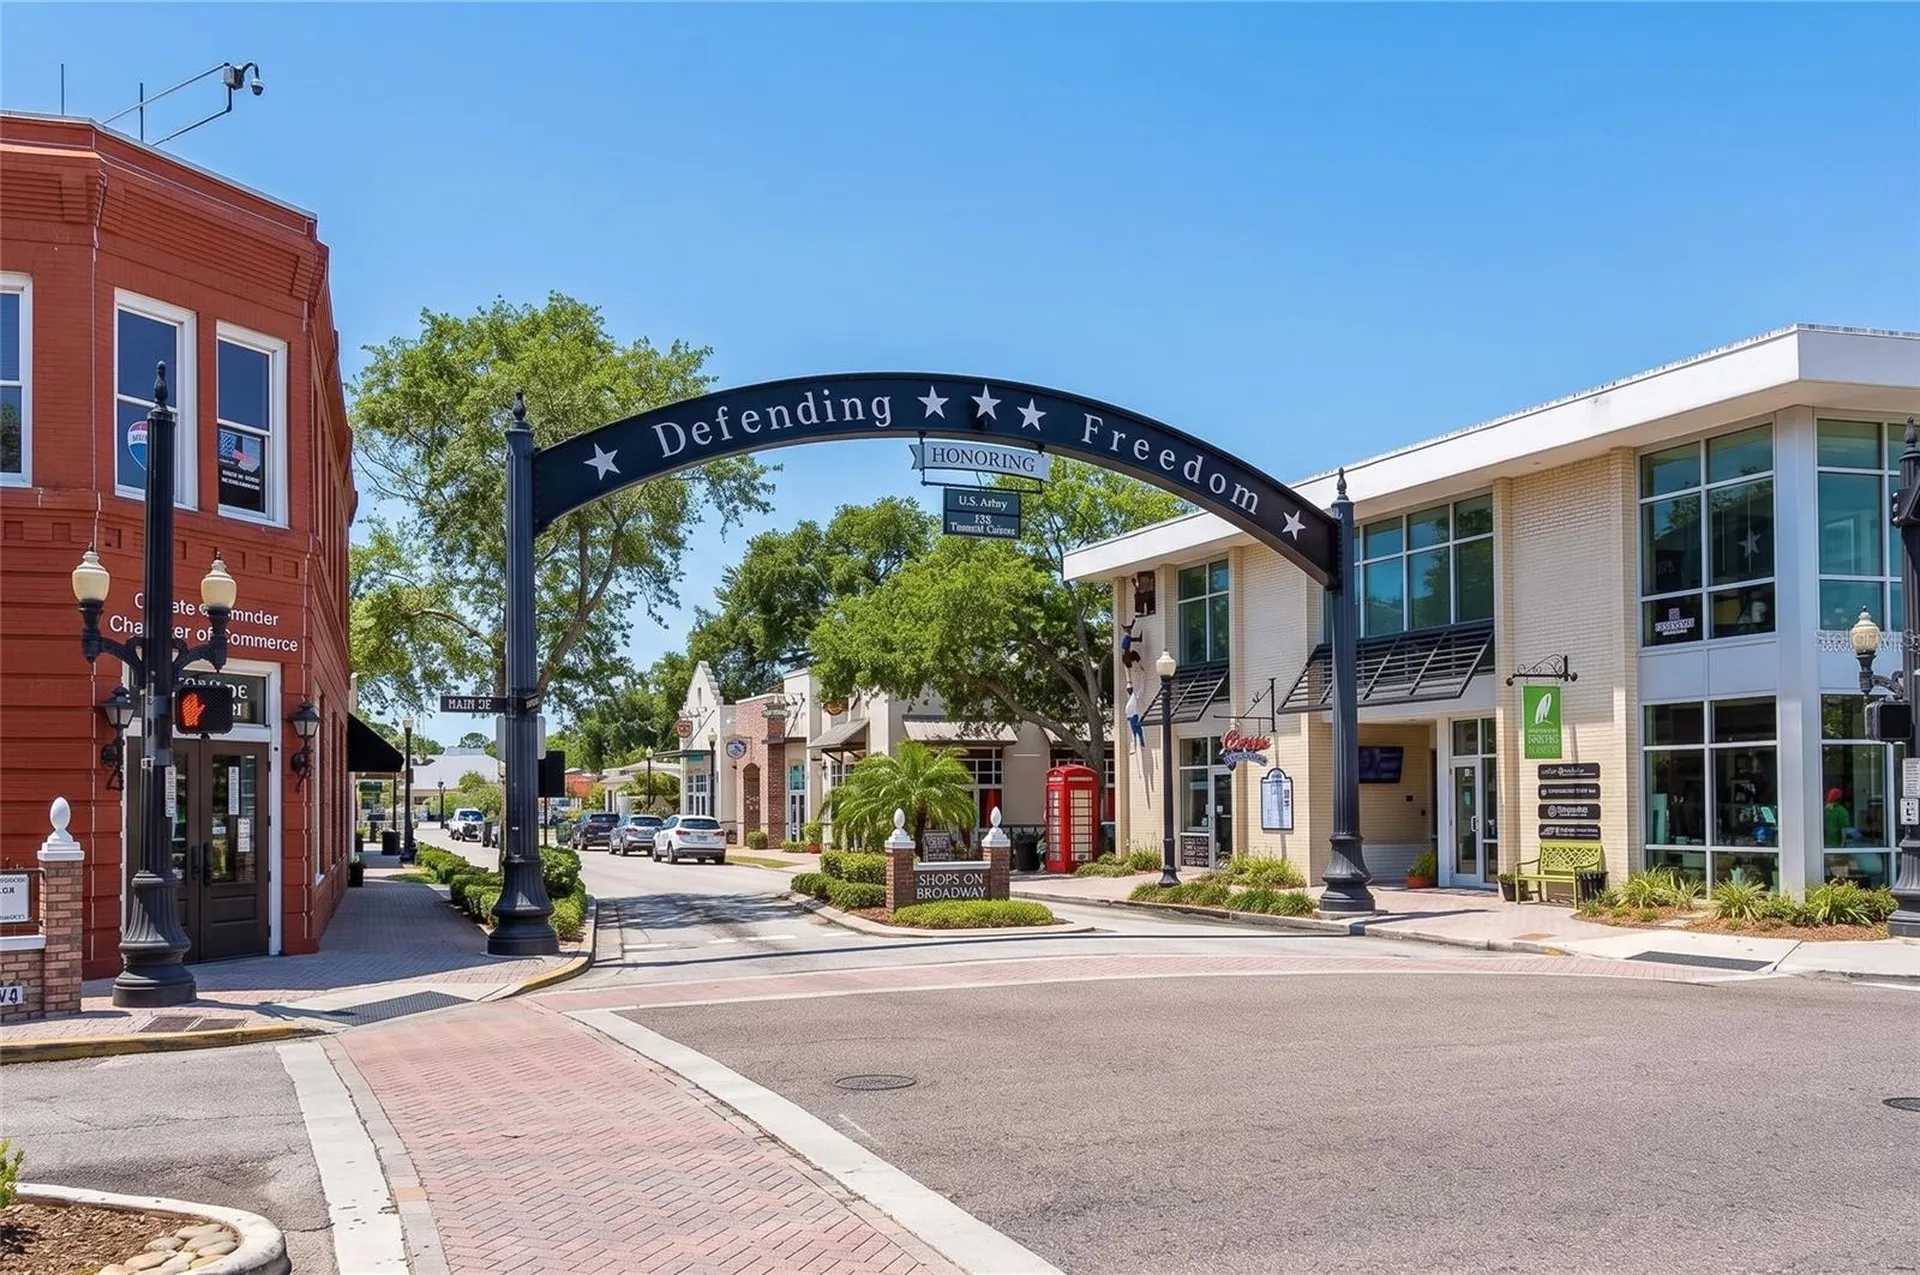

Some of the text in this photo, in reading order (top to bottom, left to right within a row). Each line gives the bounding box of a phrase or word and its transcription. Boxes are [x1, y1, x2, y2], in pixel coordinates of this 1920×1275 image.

[652, 389, 1259, 516] Defending Freedom
[932, 447, 1035, 472] HONORING
[109, 615, 191, 638] Chaer
[196, 626, 213, 641] of
[448, 699, 475, 710] MAIN
[919, 873, 983, 886] SHOPS ON
[916, 886, 987, 900] BROADWAY
